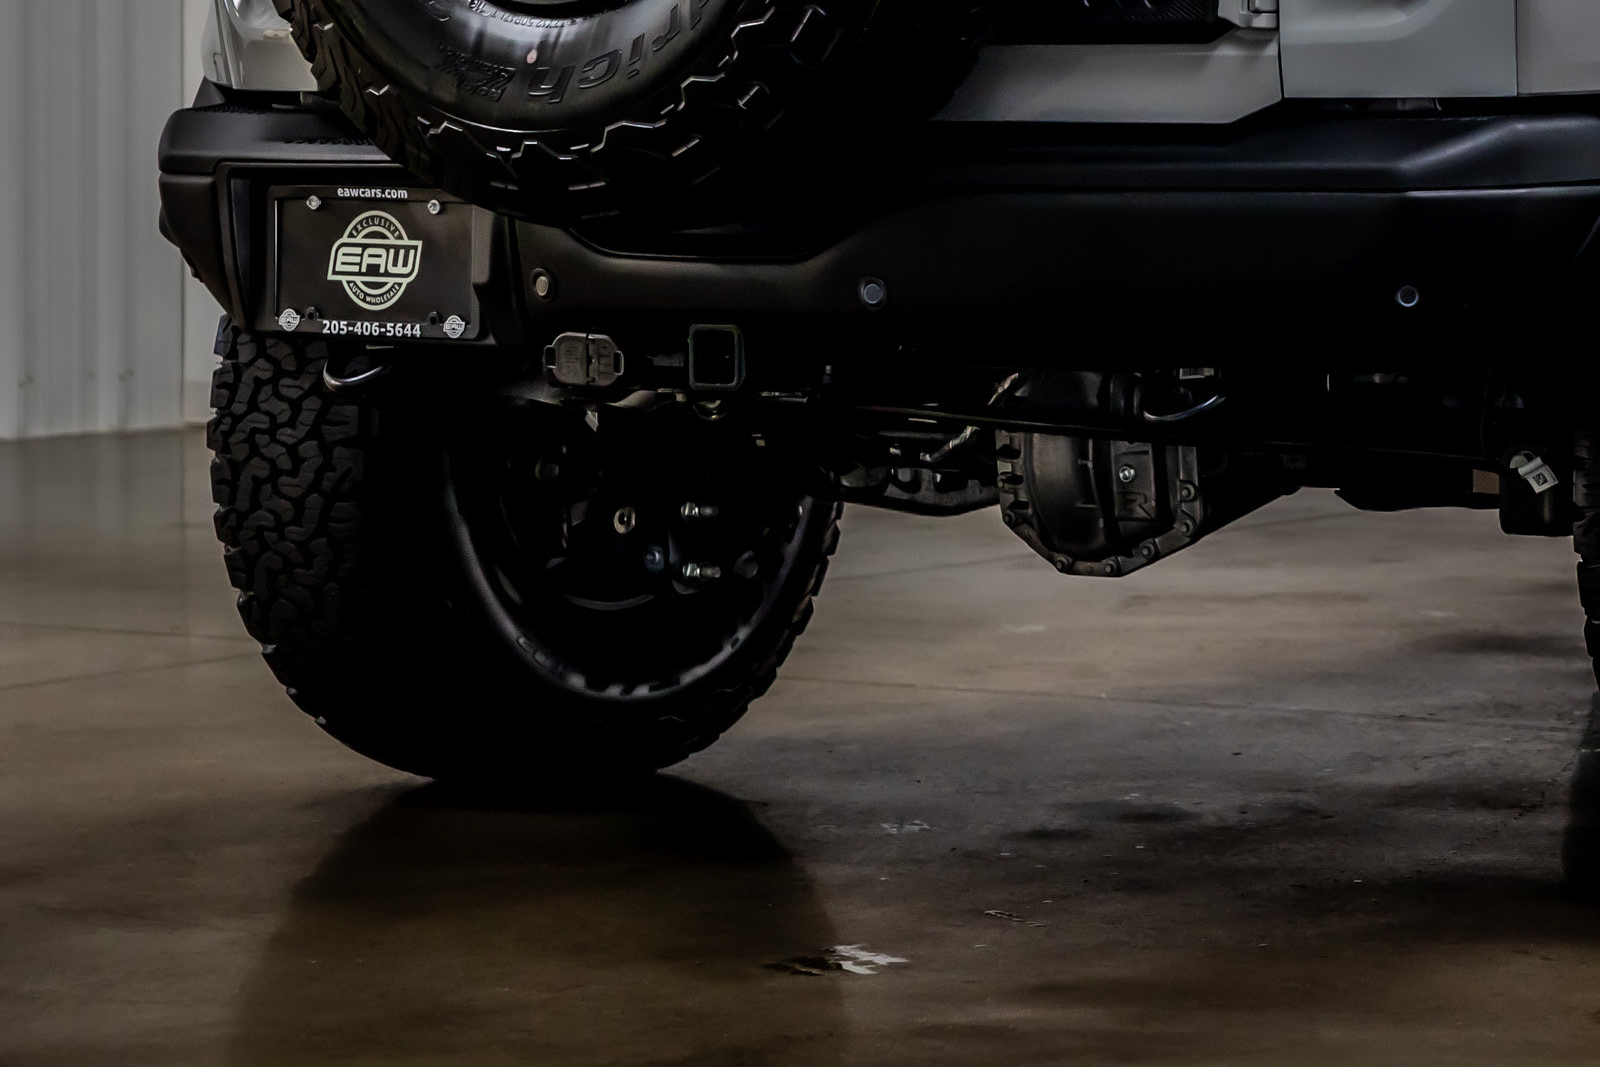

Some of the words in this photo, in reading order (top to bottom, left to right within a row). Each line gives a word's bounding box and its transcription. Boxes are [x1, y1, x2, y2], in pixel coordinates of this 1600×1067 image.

[336, 186, 409, 199] eawcars.com
[351, 216, 401, 238] EXCLUSIVE
[334, 246, 416, 274] EAW
[348, 281, 365, 300] AUTO
[365, 284, 401, 305] WHOLESALE
[322, 319, 421, 338] 205-406-5644
